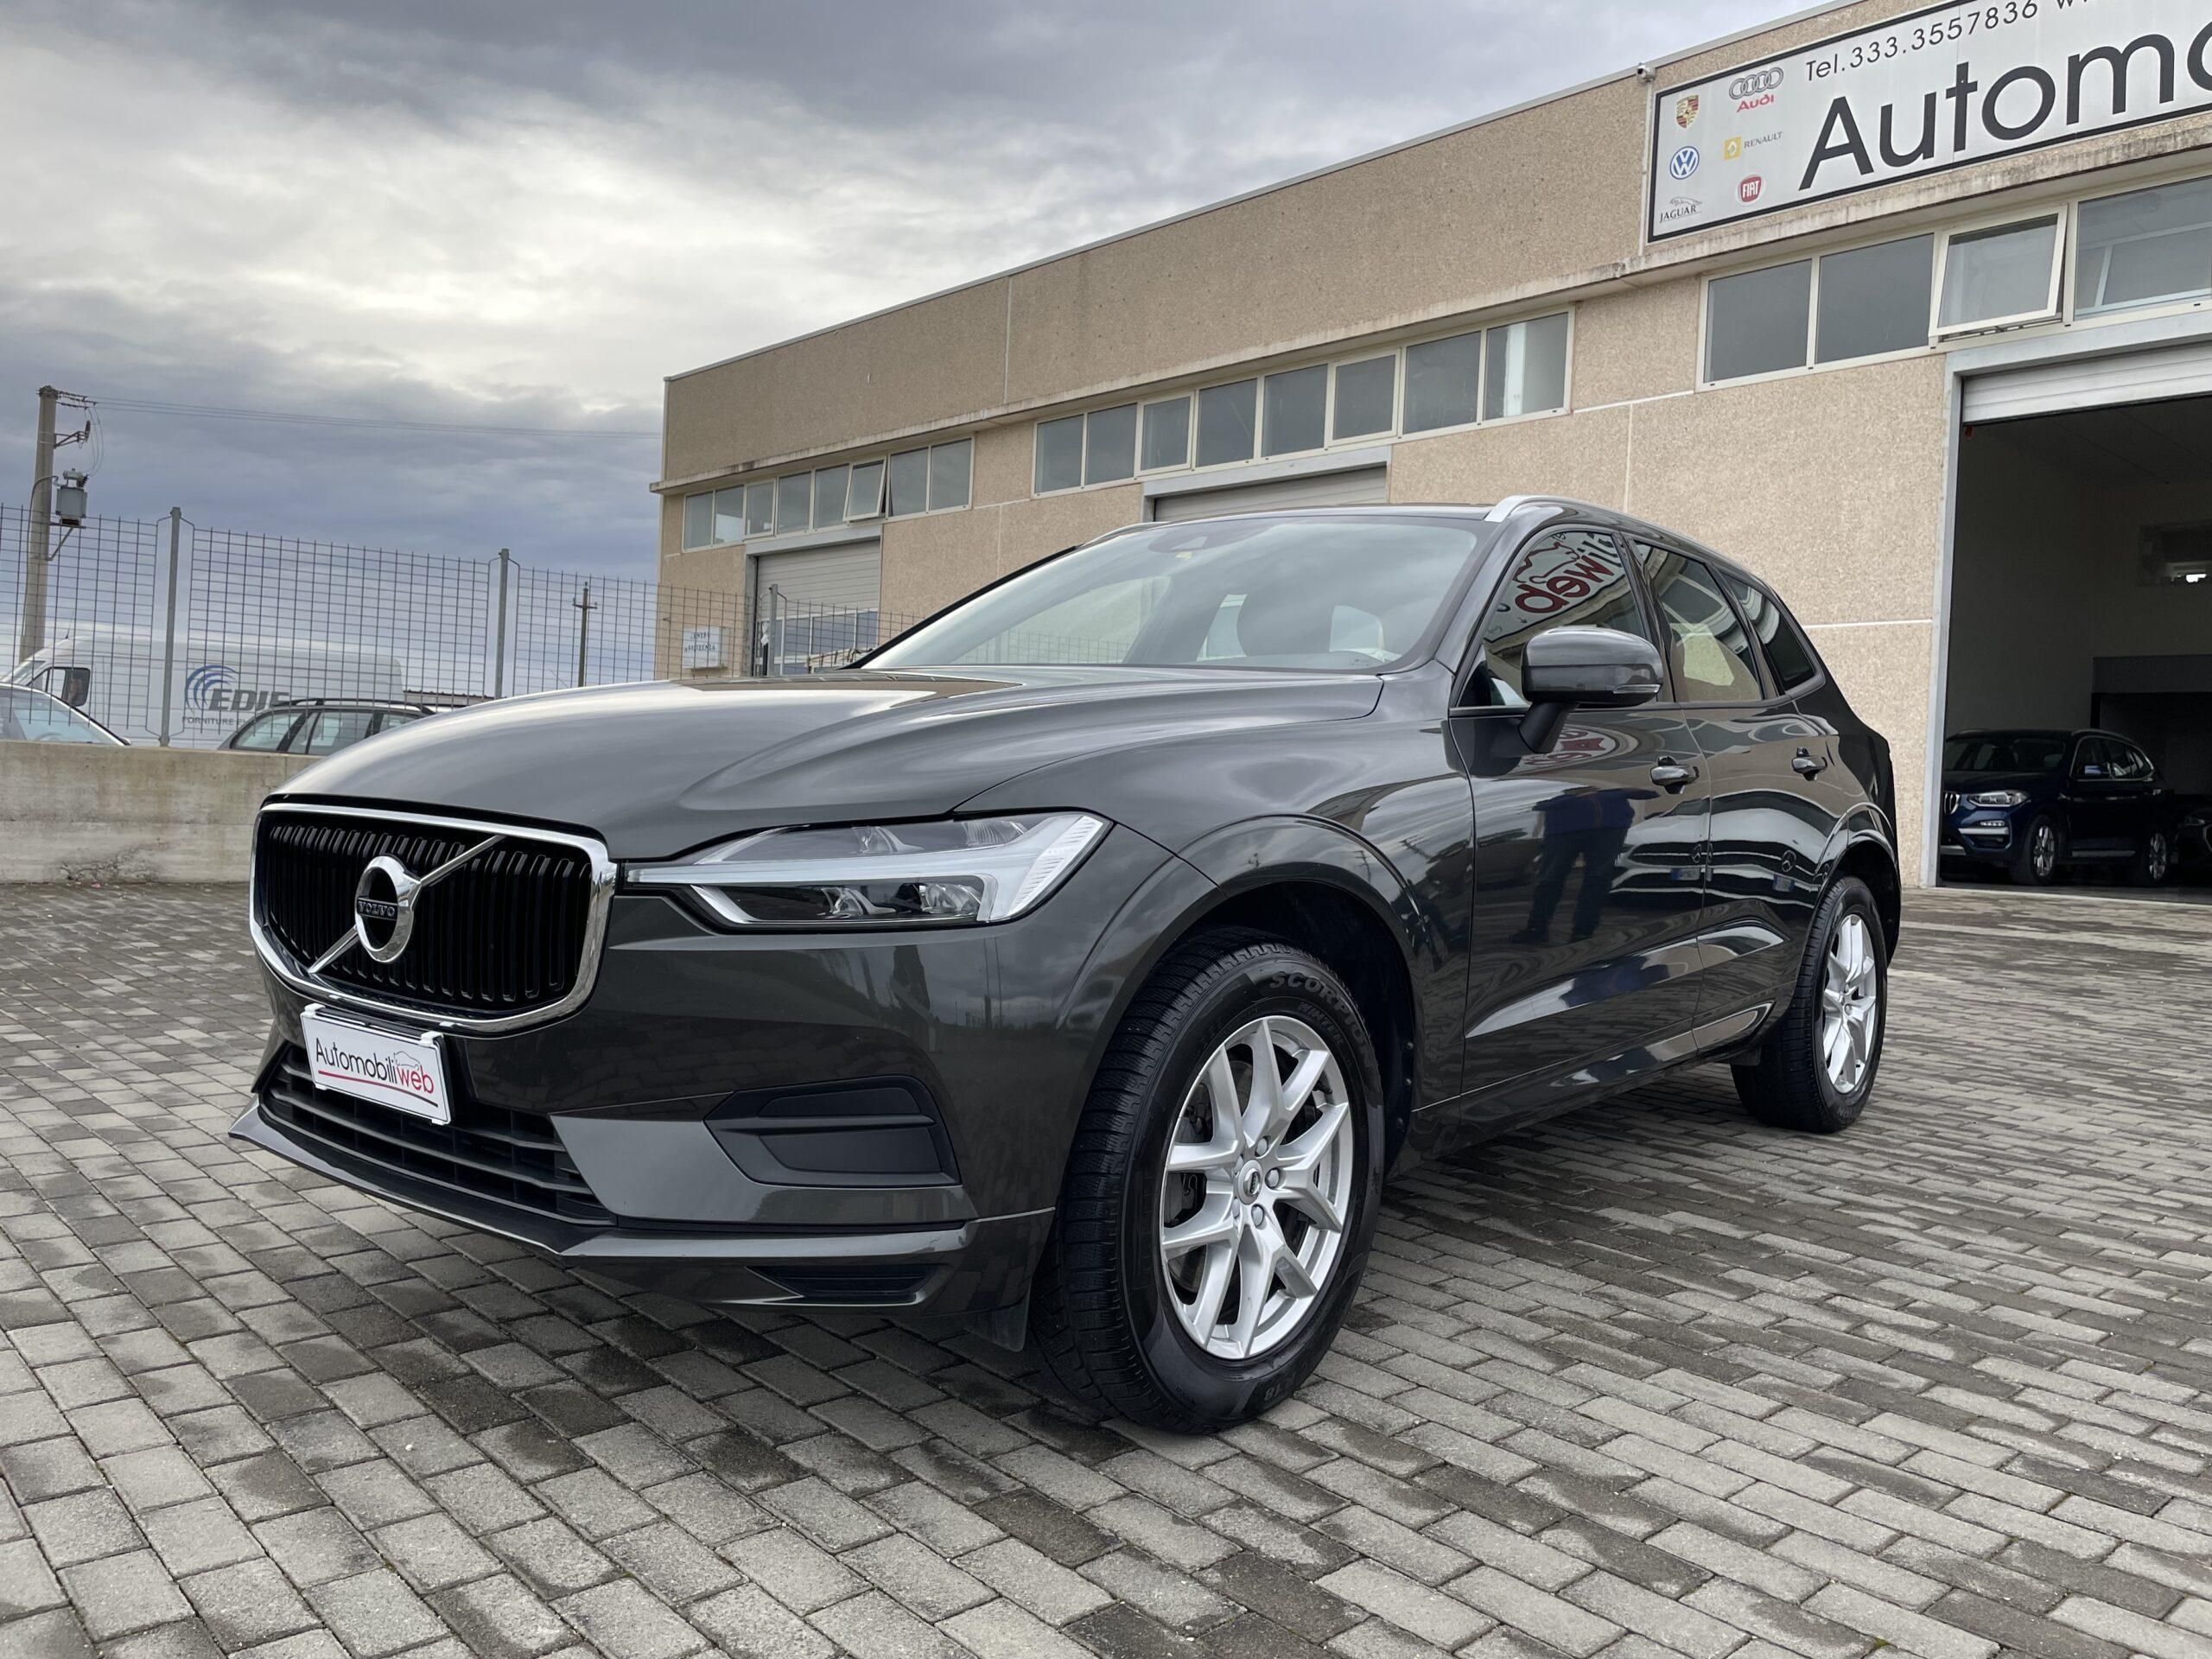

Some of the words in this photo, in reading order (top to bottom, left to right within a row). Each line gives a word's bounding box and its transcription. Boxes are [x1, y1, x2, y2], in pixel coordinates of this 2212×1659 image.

[1736, 94, 1775, 113] Audi
[1744, 131, 1783, 149] RENAULT
[1742, 180, 1760, 199] FIAT
[1660, 205, 1697, 223] JAGUAR
[358, 900, 395, 917] VOLVO
[315, 1037, 435, 1094] Automobiliweb
